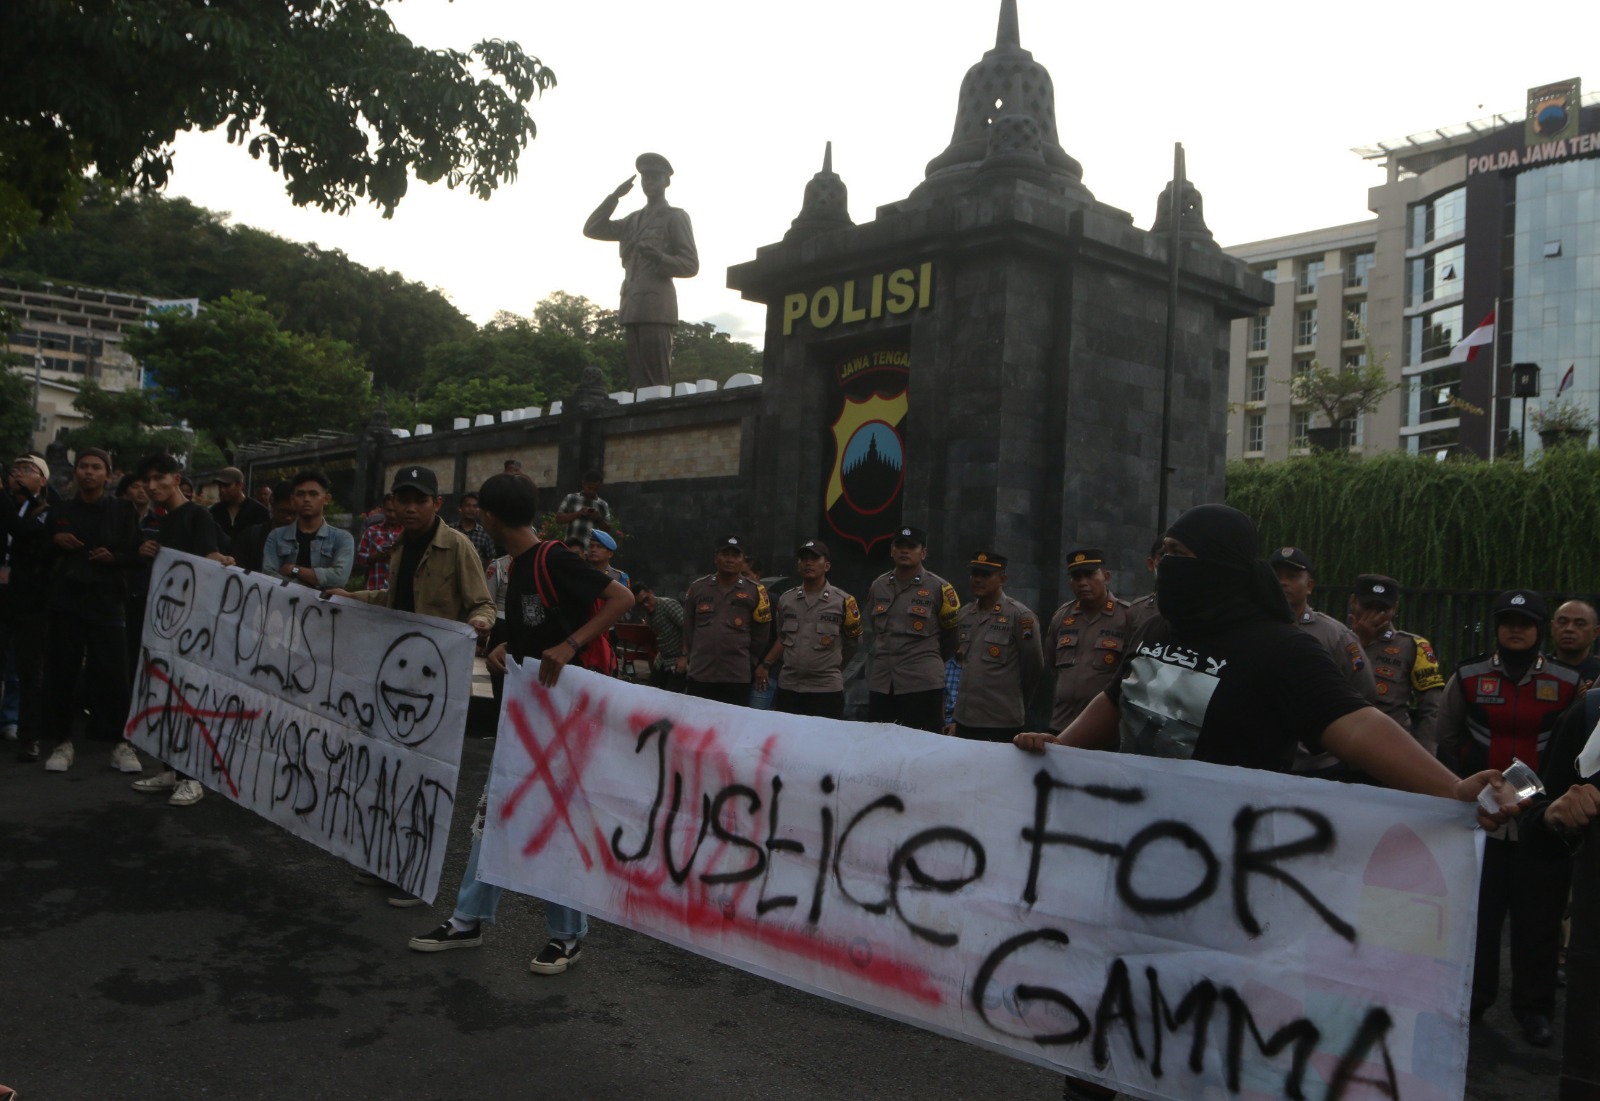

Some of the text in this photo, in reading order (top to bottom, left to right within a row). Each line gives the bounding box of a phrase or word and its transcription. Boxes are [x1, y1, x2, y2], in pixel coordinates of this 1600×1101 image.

[1468, 149, 1520, 175] POLDA
[1522, 139, 1567, 164] JAWA
[782, 262, 932, 336] POLISI
[841, 354, 870, 378] JAWA
[1020, 769, 1359, 944] FOR
[972, 928, 1398, 1101] GAMMA
